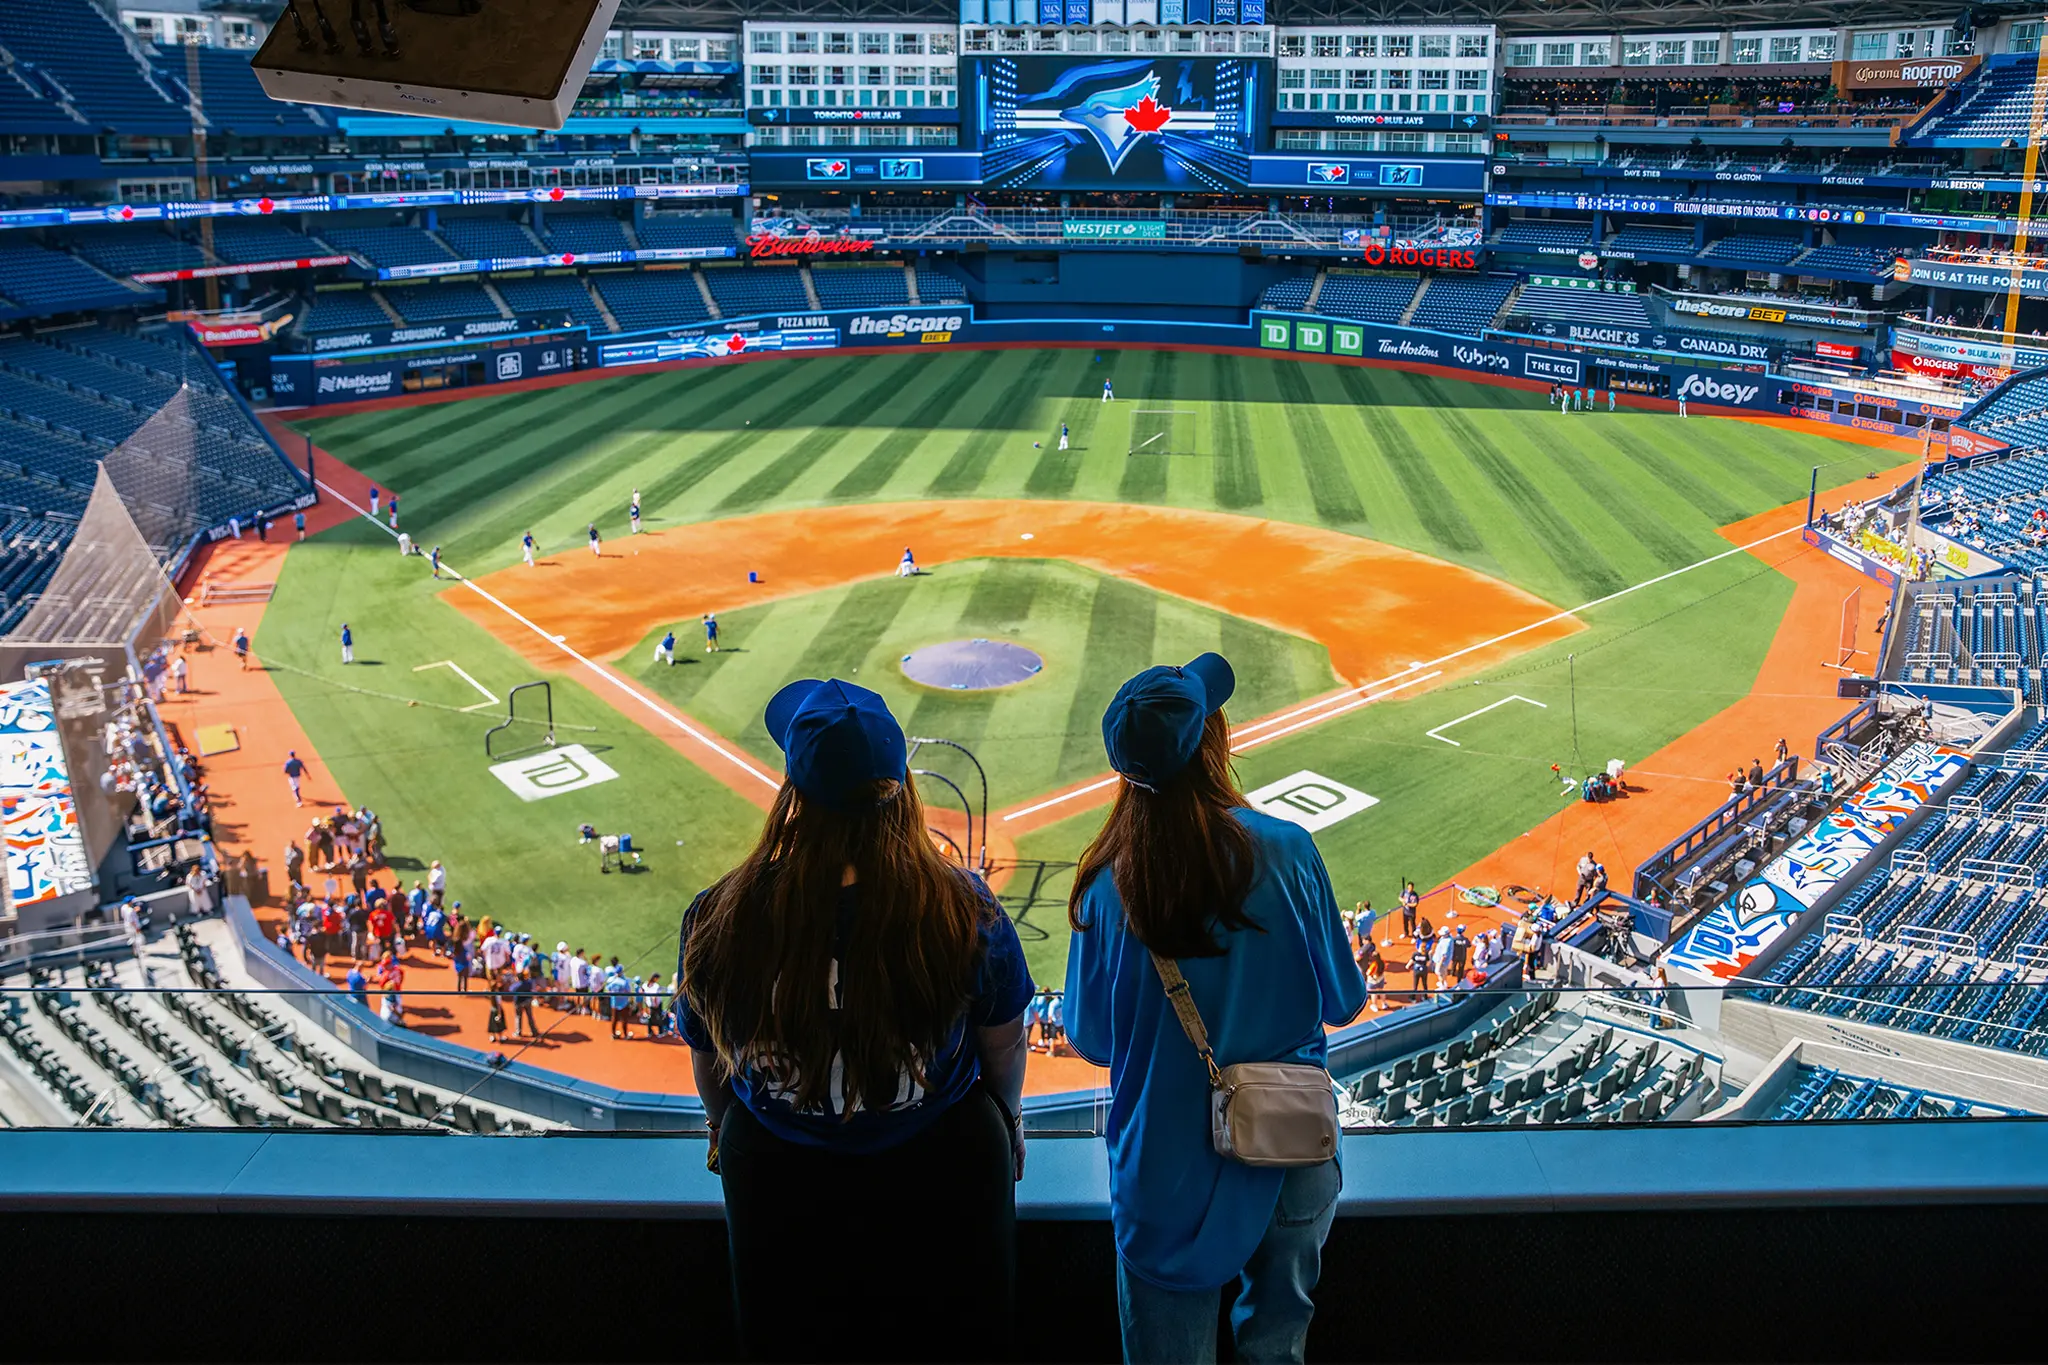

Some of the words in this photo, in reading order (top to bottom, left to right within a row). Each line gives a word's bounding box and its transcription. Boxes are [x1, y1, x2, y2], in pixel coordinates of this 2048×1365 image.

[1217, 7, 1236, 16] 2023
[1856, 67, 1900, 84] Corona
[1902, 65, 1963, 81] ROOFTOP
[813, 111, 854, 119] TORONTO
[862, 111, 881, 119] BLUE
[882, 111, 902, 119] JAYS
[1335, 115, 1375, 124] TORONTO
[1384, 115, 1404, 124] BLUE
[1404, 116, 1424, 125] JAYS
[1624, 169, 1640, 177] DAVE
[1642, 170, 1661, 178] STIEB
[1715, 172, 1732, 180] CITO
[1733, 173, 1762, 181] GASTON
[1822, 176, 1836, 184] PAT
[1837, 177, 1864, 185] GILLICK
[1931, 180, 1949, 188] PAUL
[1950, 181, 1985, 190] BEESTON
[1674, 203, 1701, 213] FOLLOW
[1701, 203, 1742, 215] @BLUEJAYS
[1743, 206, 1753, 215] ON
[1754, 207, 1779, 217] SOCIAL
[1065, 223, 1122, 237] WESTJET
[1912, 218, 1938, 226] TORONTO
[1943, 219, 1956, 227] BLUE
[745, 232, 875, 257] Budweiser
[1538, 247, 1565, 255] CANADA
[1565, 248, 1579, 256] DRY
[1390, 247, 1475, 269] ROGERS
[1601, 251, 1635, 259] BLEACHERS
[1911, 269, 1931, 280] JOIN
[1932, 271, 1946, 281] US
[1949, 272, 1964, 283] AT
[1967, 274, 1989, 285] THE
[1992, 276, 2041, 290] PORCH!
[1674, 300, 1746, 317] theScore
[1751, 310, 1784, 321] BET
[1789, 313, 1830, 324] SPORTSBOOK
[1836, 318, 1861, 328] CASINO
[464, 320, 519, 335] SUBWAY
[777, 317, 804, 328] PIZZA
[806, 316, 830, 326] NOVA
[850, 315, 962, 335] theScore
[390, 326, 447, 343] SUBWAY
[923, 333, 949, 342] BET
[1264, 324, 1288, 343] TD
[1300, 327, 1324, 346] TD
[1336, 330, 1360, 349] TD
[1569, 325, 1640, 345] BLEACHERS
[315, 333, 373, 351] SUBWAY
[1378, 339, 1399, 354] Tim
[1399, 341, 1439, 358] Hortons
[1680, 338, 1739, 356] CANADA
[1920, 342, 1957, 354] TORONTO
[1967, 349, 1988, 358] BLUE
[1989, 351, 2012, 361] JAYS
[1531, 361, 1551, 371] THE
[1553, 364, 1573, 375] KEG
[1595, 357, 1616, 366] Active
[1923, 358, 1959, 371] ROGERS
[336, 372, 392, 391] National
[1677, 374, 1759, 405] Sobeys
[1801, 386, 1833, 398] ROGERS
[1863, 395, 1898, 409] ROGERS
[1799, 409, 1831, 422] ROGERS
[1861, 421, 1895, 434] ROGERS
[1951, 435, 1975, 453] HEINZ
[1262, 783, 1347, 815] TD
[1841, 1029, 1874, 1046] BLUEPRINT
[1875, 1043, 1891, 1053] CLUB
